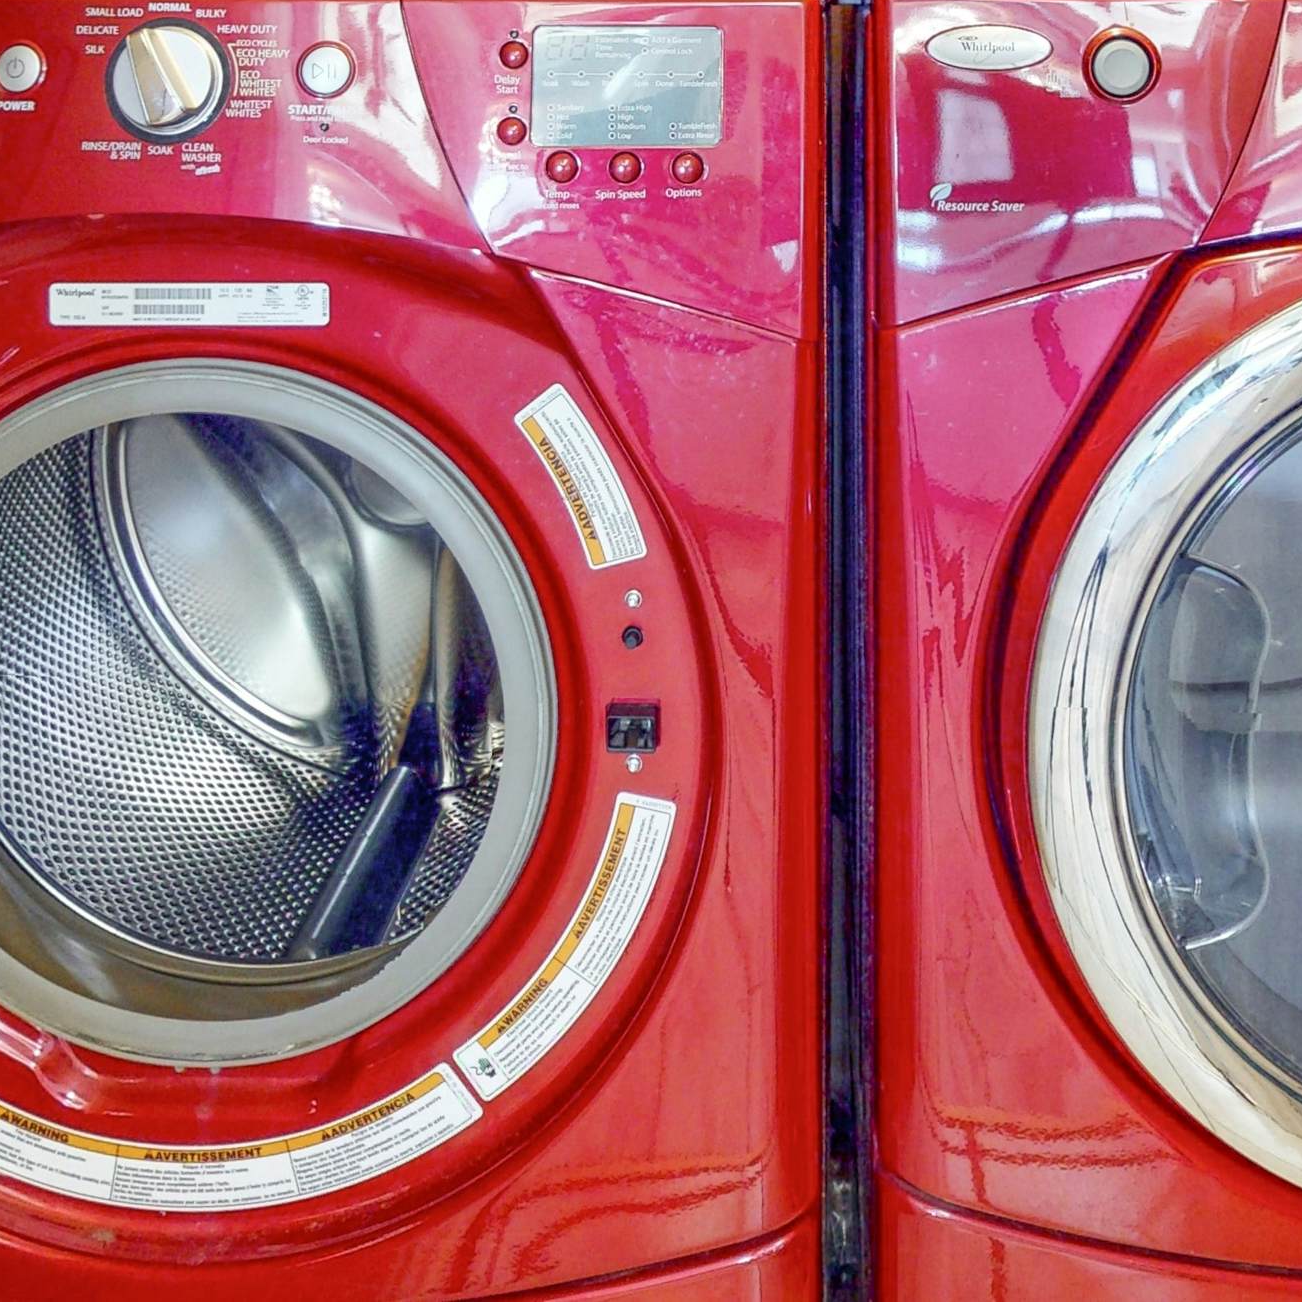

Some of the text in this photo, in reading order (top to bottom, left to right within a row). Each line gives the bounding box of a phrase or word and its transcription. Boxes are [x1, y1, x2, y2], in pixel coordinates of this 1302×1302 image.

[148, 2, 192, 12] NORMAL
[85, 7, 144, 18] SMALL LOAD
[196, 9, 227, 18] BULKY
[76, 25, 119, 34] DELICATE
[217, 25, 278, 34] HEAVY DUTY
[236, 39, 278, 47] ECO CYCLES
[85, 45, 105, 54] SILK
[961, 41, 1015, 55] Whirlpool
[236, 49, 290, 58] ECO HEAVY
[239, 58, 266, 66] DUTY
[240, 71, 260, 79] ECO
[494, 74, 520, 85] Delay
[240, 79, 282, 88] WHITEST
[239, 88, 276, 97] WHITES
[496, 85, 518, 94] Start
[230, 100, 273, 109] WHITEST
[225, 109, 262, 118] WHITES
[81, 141, 142, 151] RINSE/DRAIN
[148, 146, 174, 155] SOAK
[182, 143, 214, 152] CLEAN
[110, 151, 141, 160] & SPIN
[182, 153, 222, 162] WASHER
[544, 189, 571, 200] Temp
[595, 189, 647, 200] Spin Speed
[665, 187, 703, 199] Options
[937, 200, 1025, 212] Resource Saver
[539, 436, 596, 532] ADVERTENCIA
[574, 828, 627, 934] AVERTISSEMENT
[502, 978, 549, 1027] WARNING
[330, 1092, 416, 1138] ADVERTENCIA
[10, 1113, 69, 1145] WARNING
[155, 1146, 263, 1163] AVERTISSEMENT
